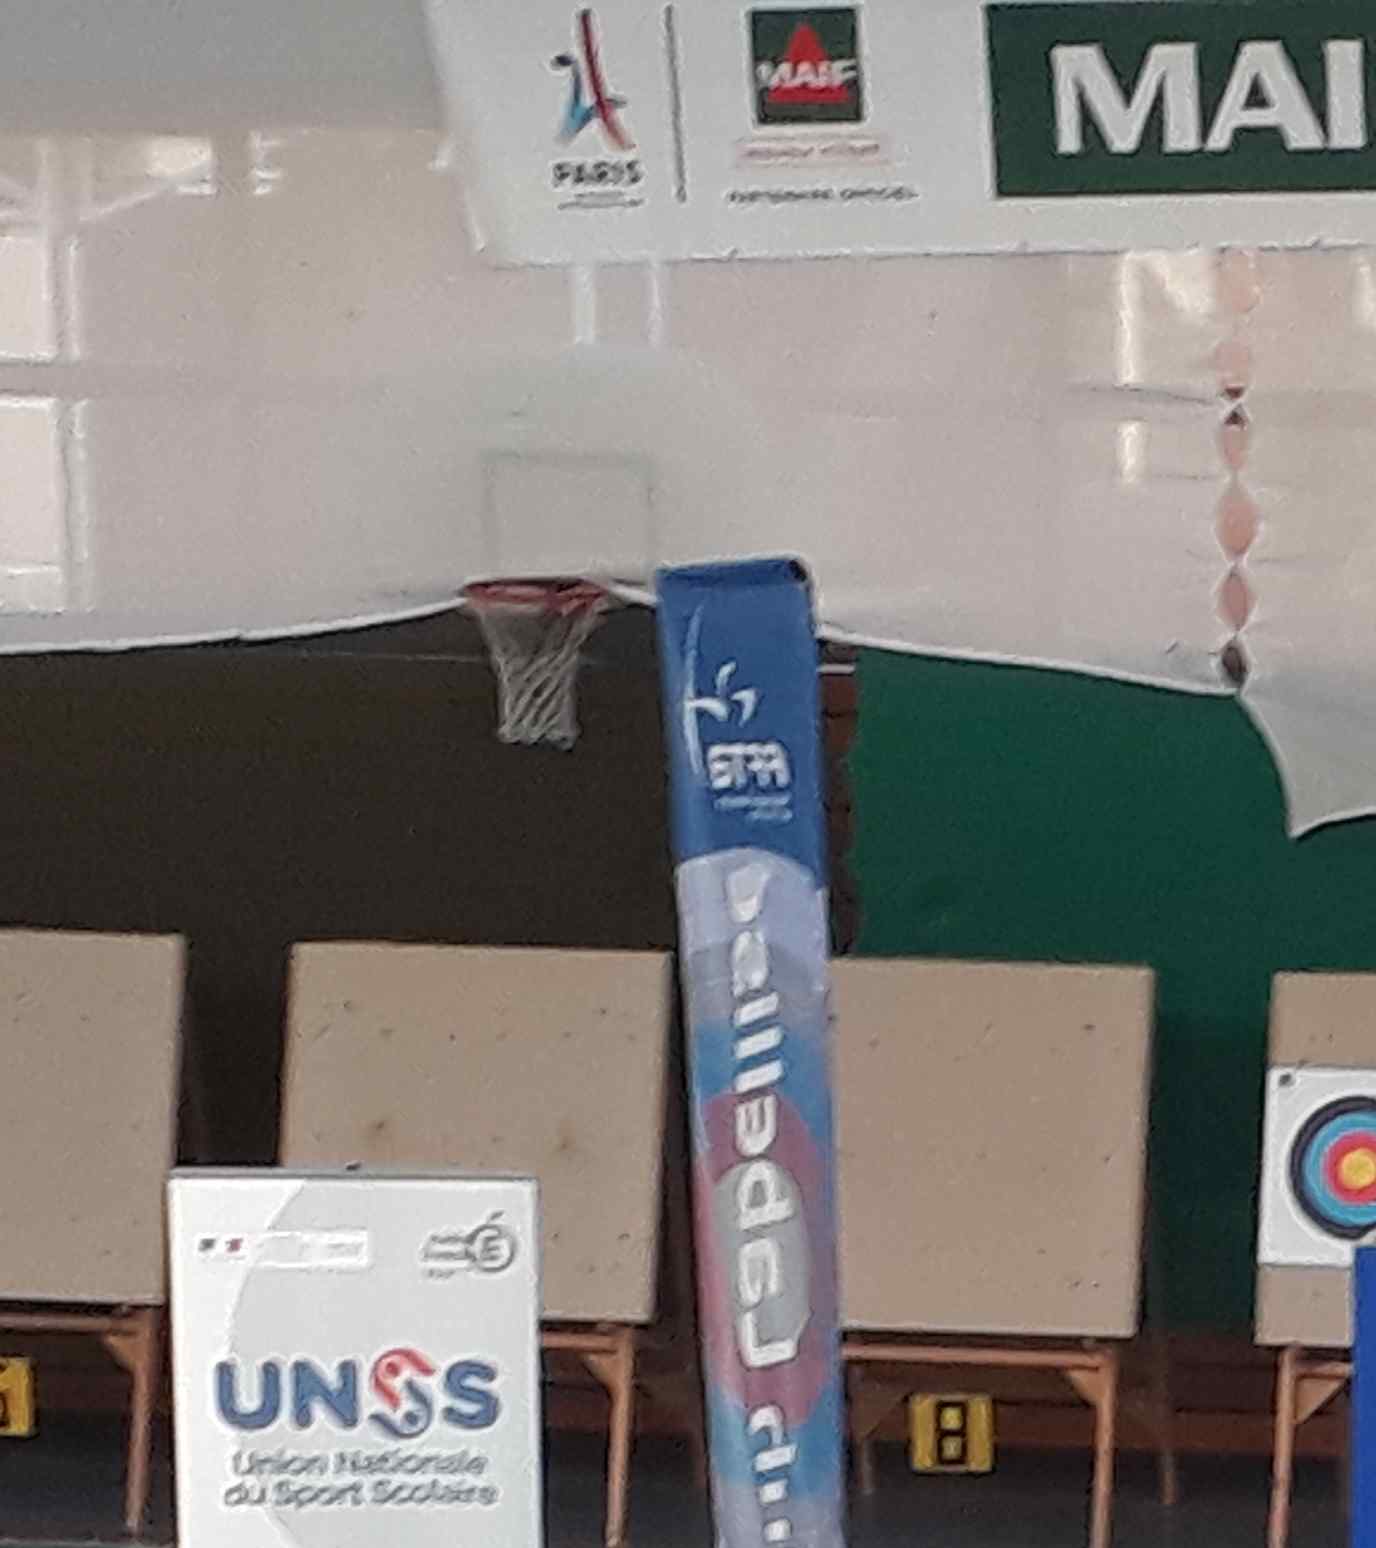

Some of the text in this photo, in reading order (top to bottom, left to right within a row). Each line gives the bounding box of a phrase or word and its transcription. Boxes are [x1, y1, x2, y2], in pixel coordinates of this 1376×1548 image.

[756, 58, 858, 88] MAIF
[935, 1401, 967, 1465] 8
[233, 1449, 489, 1475] Union Nationale
[224, 1479, 499, 1509] du Sport Scolaire
